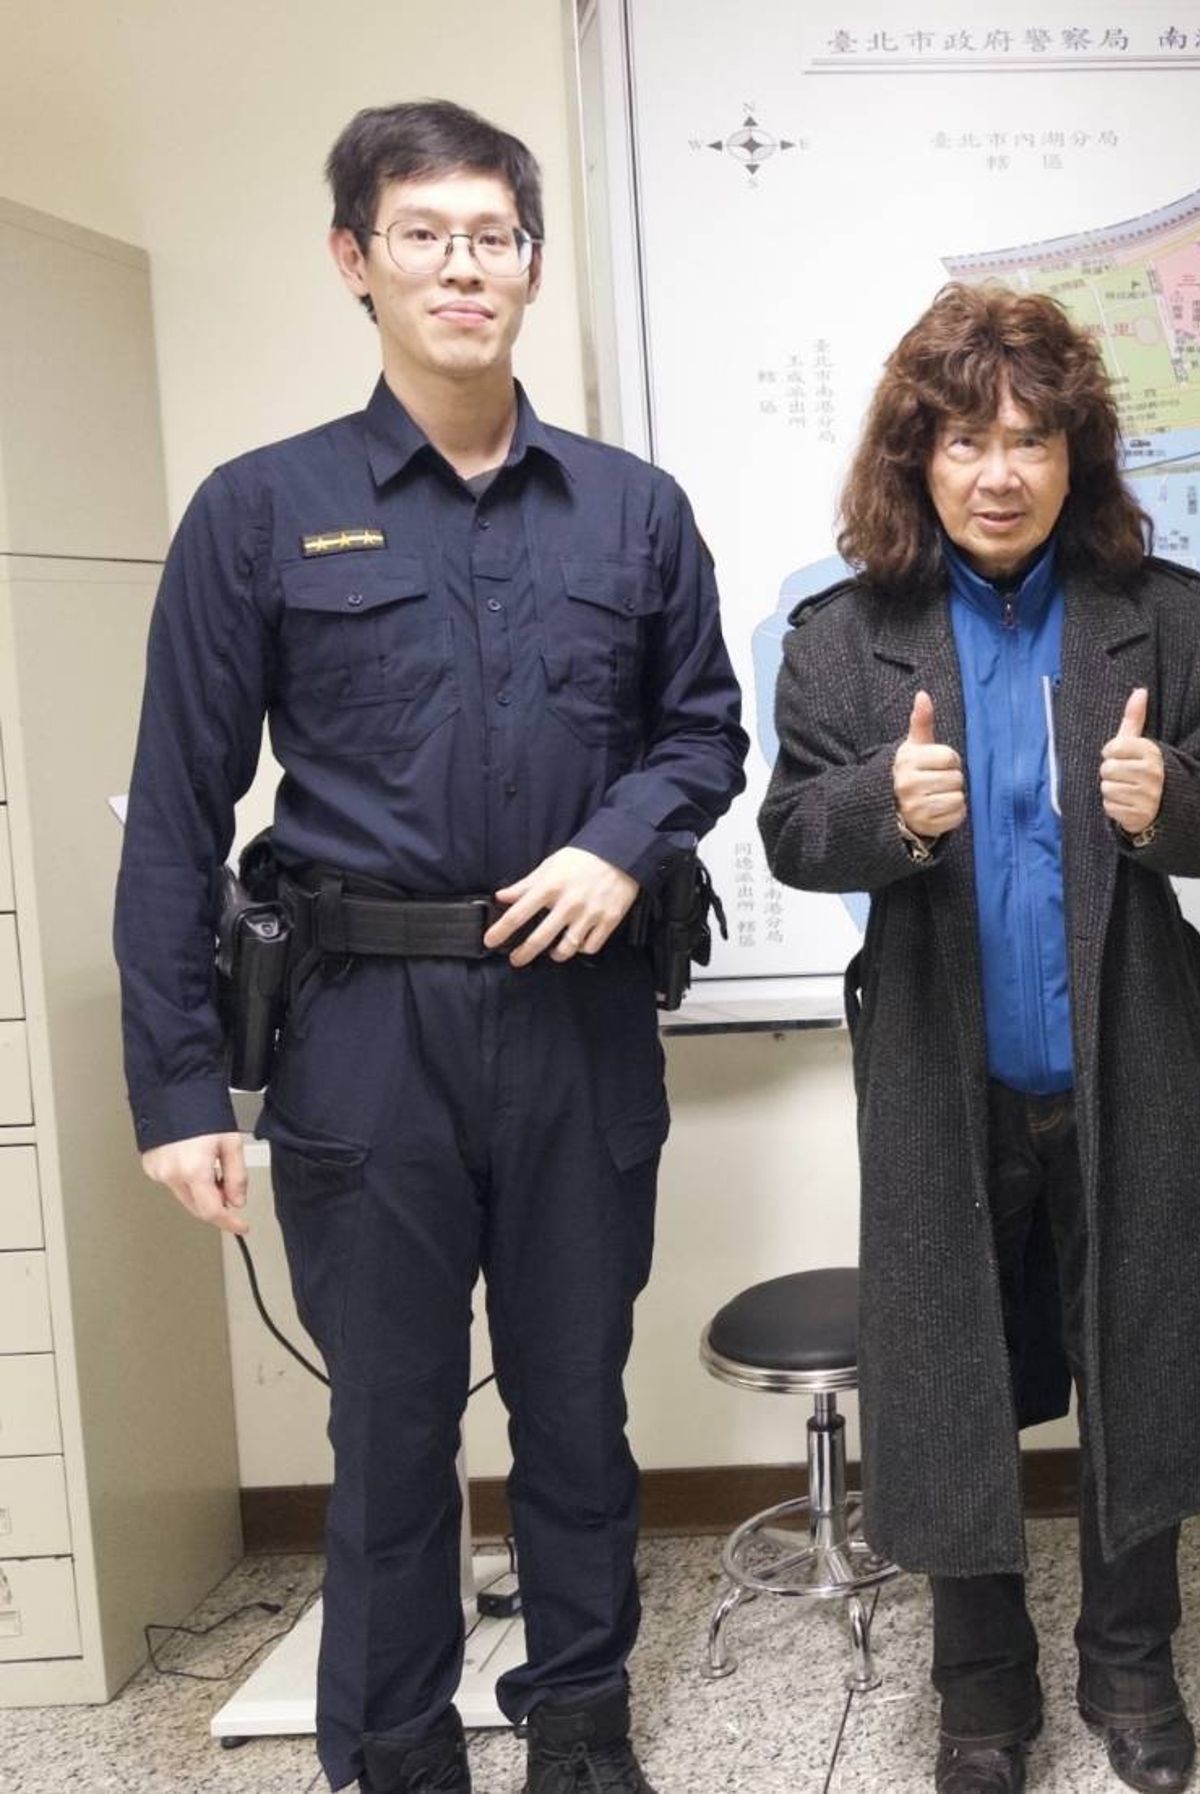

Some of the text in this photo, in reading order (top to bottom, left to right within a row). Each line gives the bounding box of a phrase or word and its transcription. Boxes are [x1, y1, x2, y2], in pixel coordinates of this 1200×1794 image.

[827, 27, 1130, 54] 臺北市政府警察局
[930, 130, 1120, 148] 臺北市內湖分局
